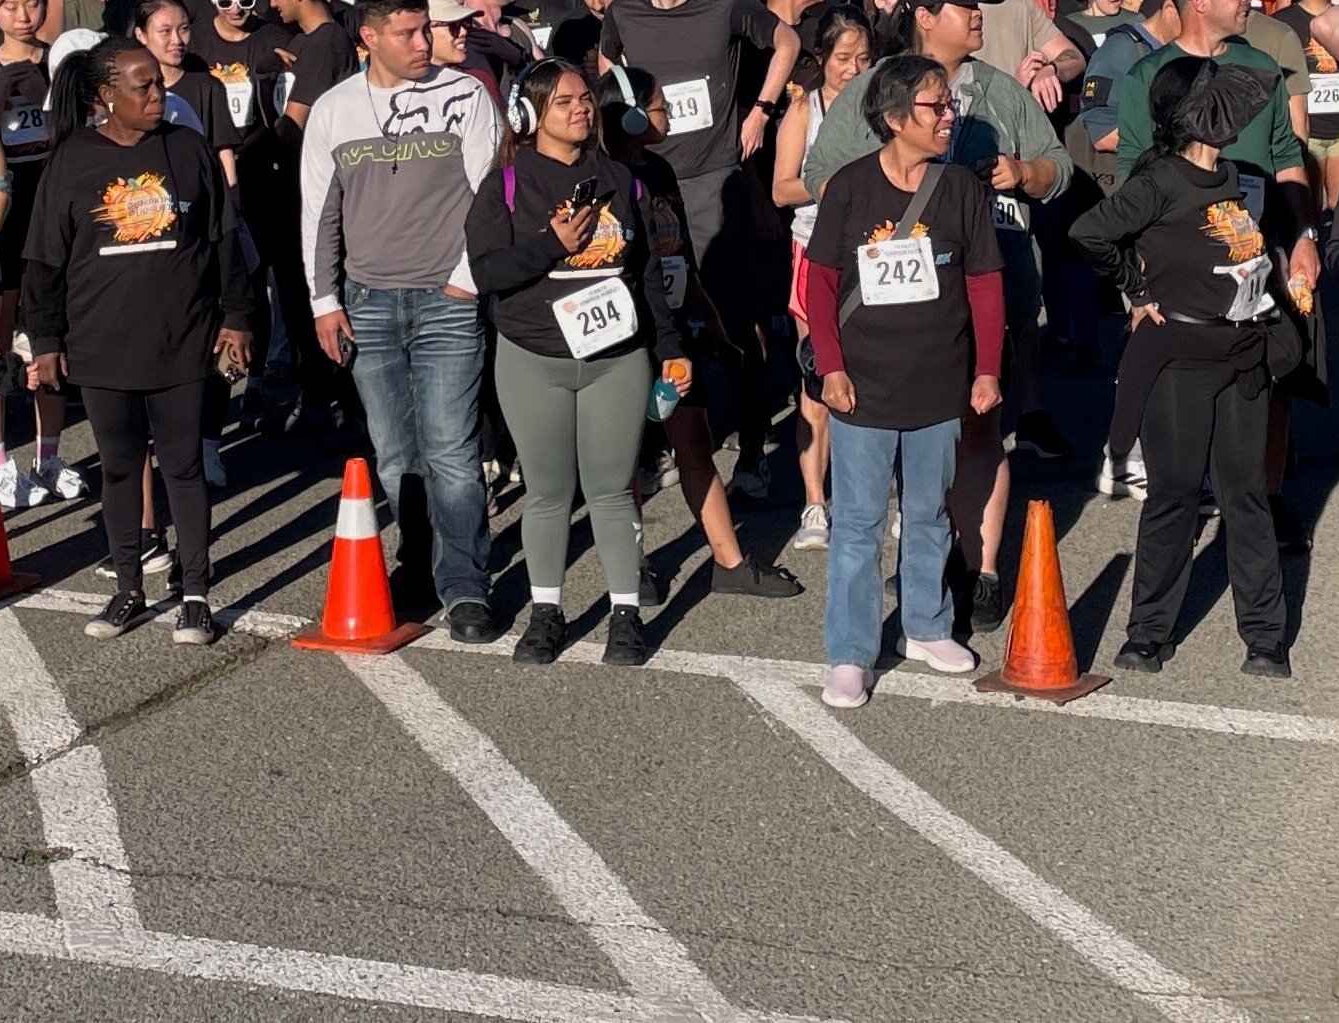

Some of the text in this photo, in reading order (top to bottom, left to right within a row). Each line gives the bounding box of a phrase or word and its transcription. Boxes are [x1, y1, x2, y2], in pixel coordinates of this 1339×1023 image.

[1314, 88, 1339, 103] 226
[876, 259, 922, 286] 242
[576, 300, 621, 336] 294
